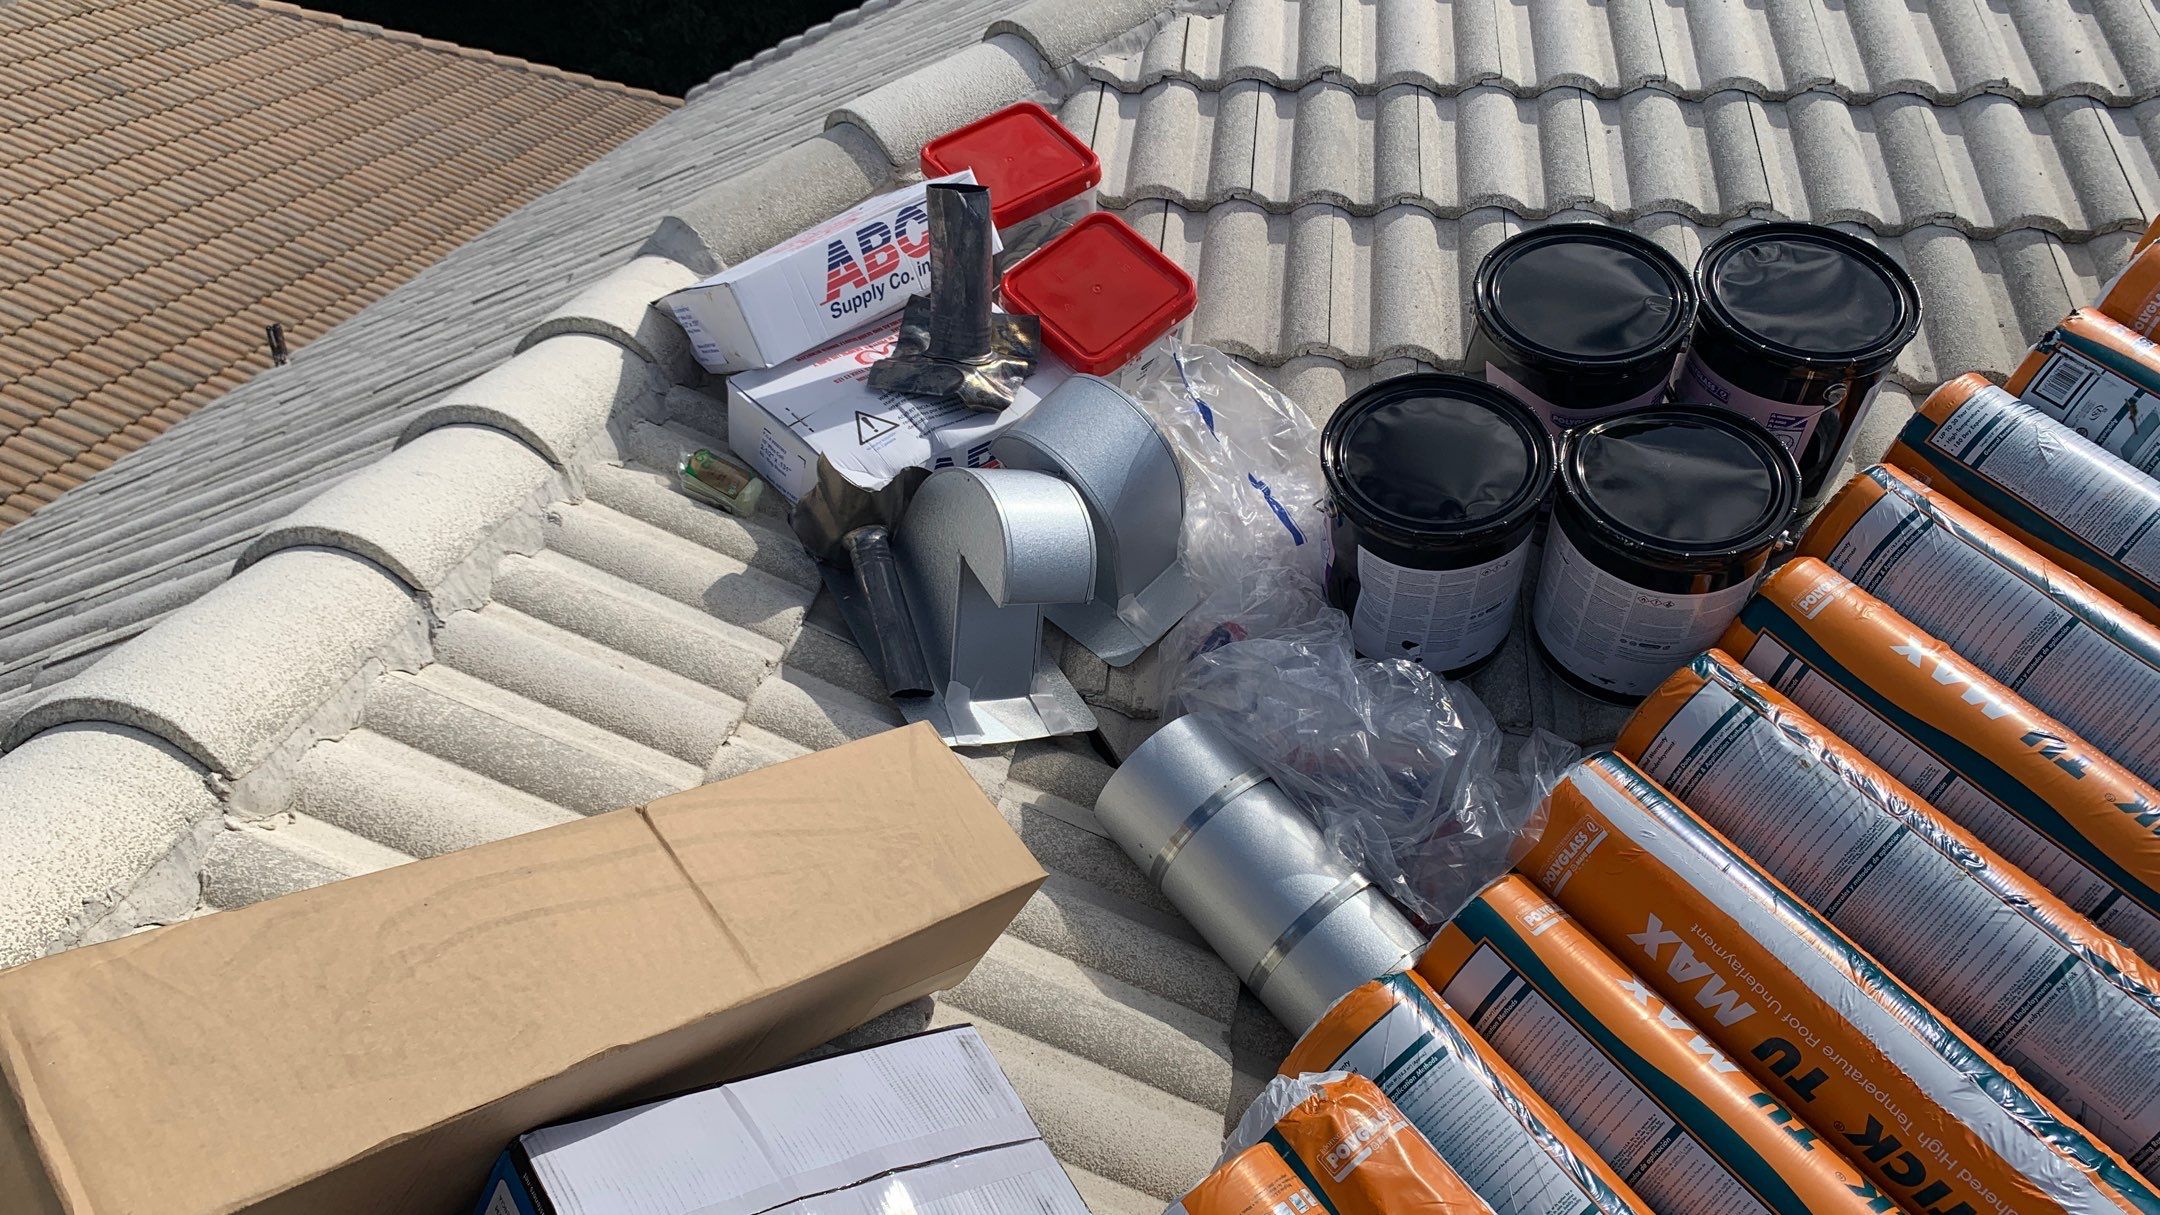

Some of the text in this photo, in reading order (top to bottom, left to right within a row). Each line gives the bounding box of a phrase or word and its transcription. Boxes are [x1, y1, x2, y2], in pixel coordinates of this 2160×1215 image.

[820, 203, 931, 306] ABC
[830, 260, 932, 319] Supply Co. in
[2134, 293, 2160, 330] OLYGL
[1938, 431, 1946, 439] UP
[1945, 424, 1953, 432] TO
[1950, 417, 1959, 425] 30
[1957, 409, 1968, 420] Year
[1945, 408, 1981, 444] High-Temperature
[1953, 411, 1988, 448] 180 Day Exposure
[1983, 437, 2001, 456] General
[1830, 540, 1852, 563] Warranty
[1835, 546, 1859, 572] derlayment
[1861, 558, 1873, 570] Data
[1882, 543, 1908, 571] Application
[1904, 527, 1924, 547] Methods
[2024, 652, 2044, 675] métodos
[2041, 646, 2050, 655] de
[2047, 623, 2071, 649] aplicación
[1889, 634, 2020, 721] MAX
[1647, 735, 1669, 759] Warranty
[1703, 739, 1731, 768] Application
[1727, 720, 1748, 742] Methods
[2020, 728, 2094, 781] TU
[1665, 766, 1684, 785] Product
[1679, 755, 1692, 768] Data
[1539, 829, 1591, 887] POLYGLASS
[1827, 887, 1851, 913] Generales
[1851, 862, 1873, 886] métodos
[1870, 854, 1880, 864] de
[1877, 831, 1901, 858] aplicación
[1628, 913, 1757, 1028] MAX
[1690, 923, 1783, 1015] Underlayment
[1494, 997, 1520, 1022] Methods
[1993, 1017, 2016, 1043] Polystick
[2012, 978, 2052, 1023] Underlayments
[2012, 1022, 2030, 1041] capas
[2026, 990, 2059, 1026] subyacentes
[2055, 969, 2078, 994] Polystick
[1781, 1011, 1821, 1048] Roof
[1388, 1054, 1439, 1102] pplication Methods
[1751, 1037, 1830, 1103] TU
[1823, 1044, 1913, 1136] Temperature
[1638, 1161, 1648, 1171] de
[1643, 1134, 1673, 1166] aplicación
[1918, 1131, 1957, 1170] High
